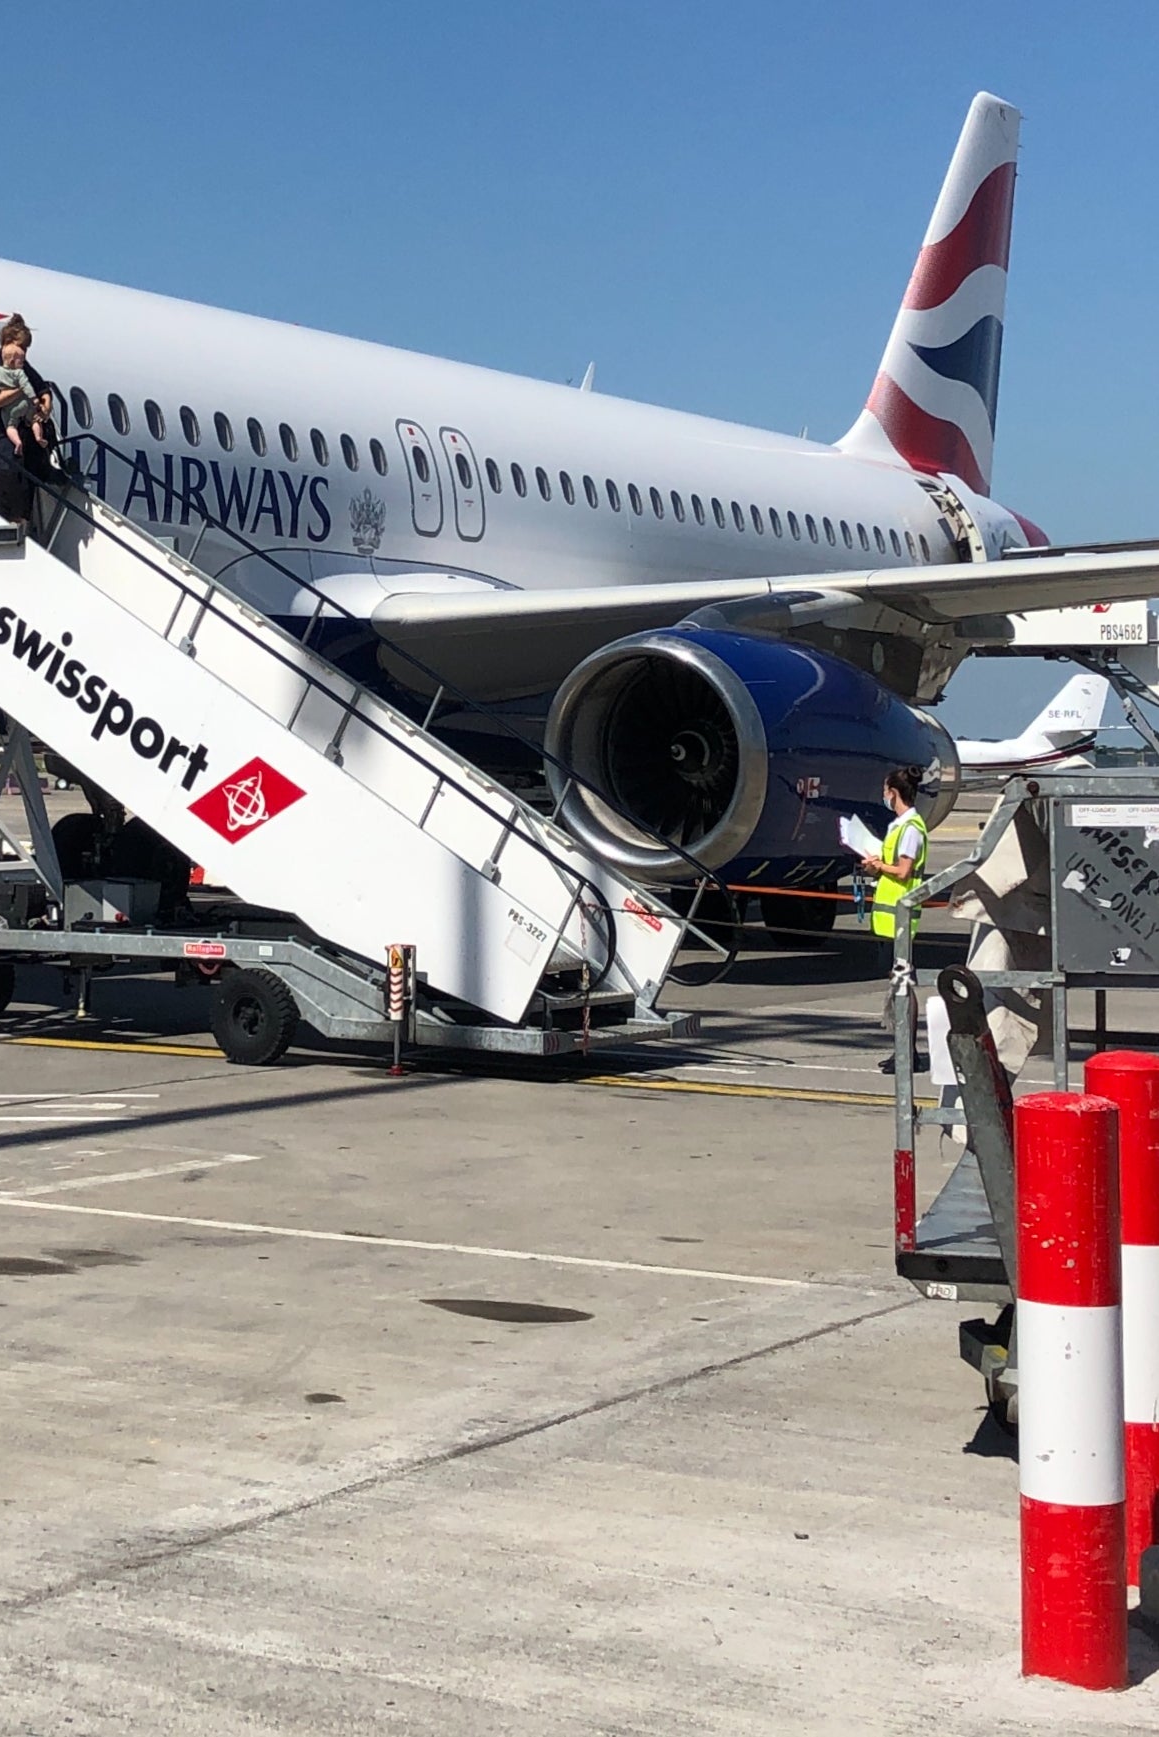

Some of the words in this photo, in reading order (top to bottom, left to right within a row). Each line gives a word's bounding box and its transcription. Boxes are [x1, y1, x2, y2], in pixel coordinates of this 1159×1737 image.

[122, 449, 331, 542] AIRWAYS
[1100, 624, 1143, 640] PBS4682
[1066, 852, 1109, 895] USE
